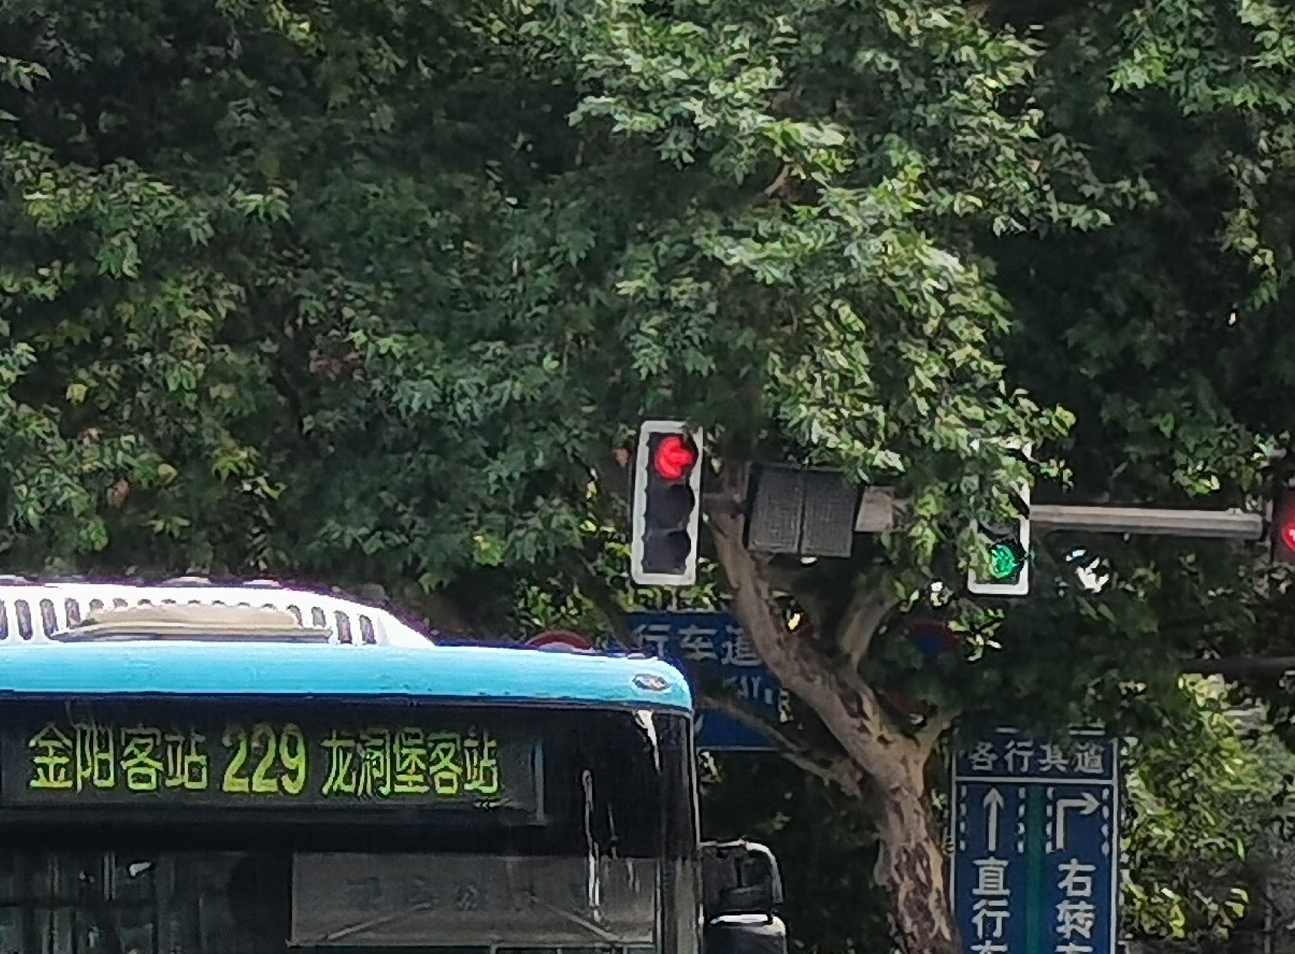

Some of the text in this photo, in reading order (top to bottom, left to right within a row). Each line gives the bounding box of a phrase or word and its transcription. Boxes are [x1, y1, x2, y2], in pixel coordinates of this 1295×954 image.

[28, 723, 501, 797] 金阳客站 229 龙洞堡客站
[969, 739, 1105, 774] 各行其道
